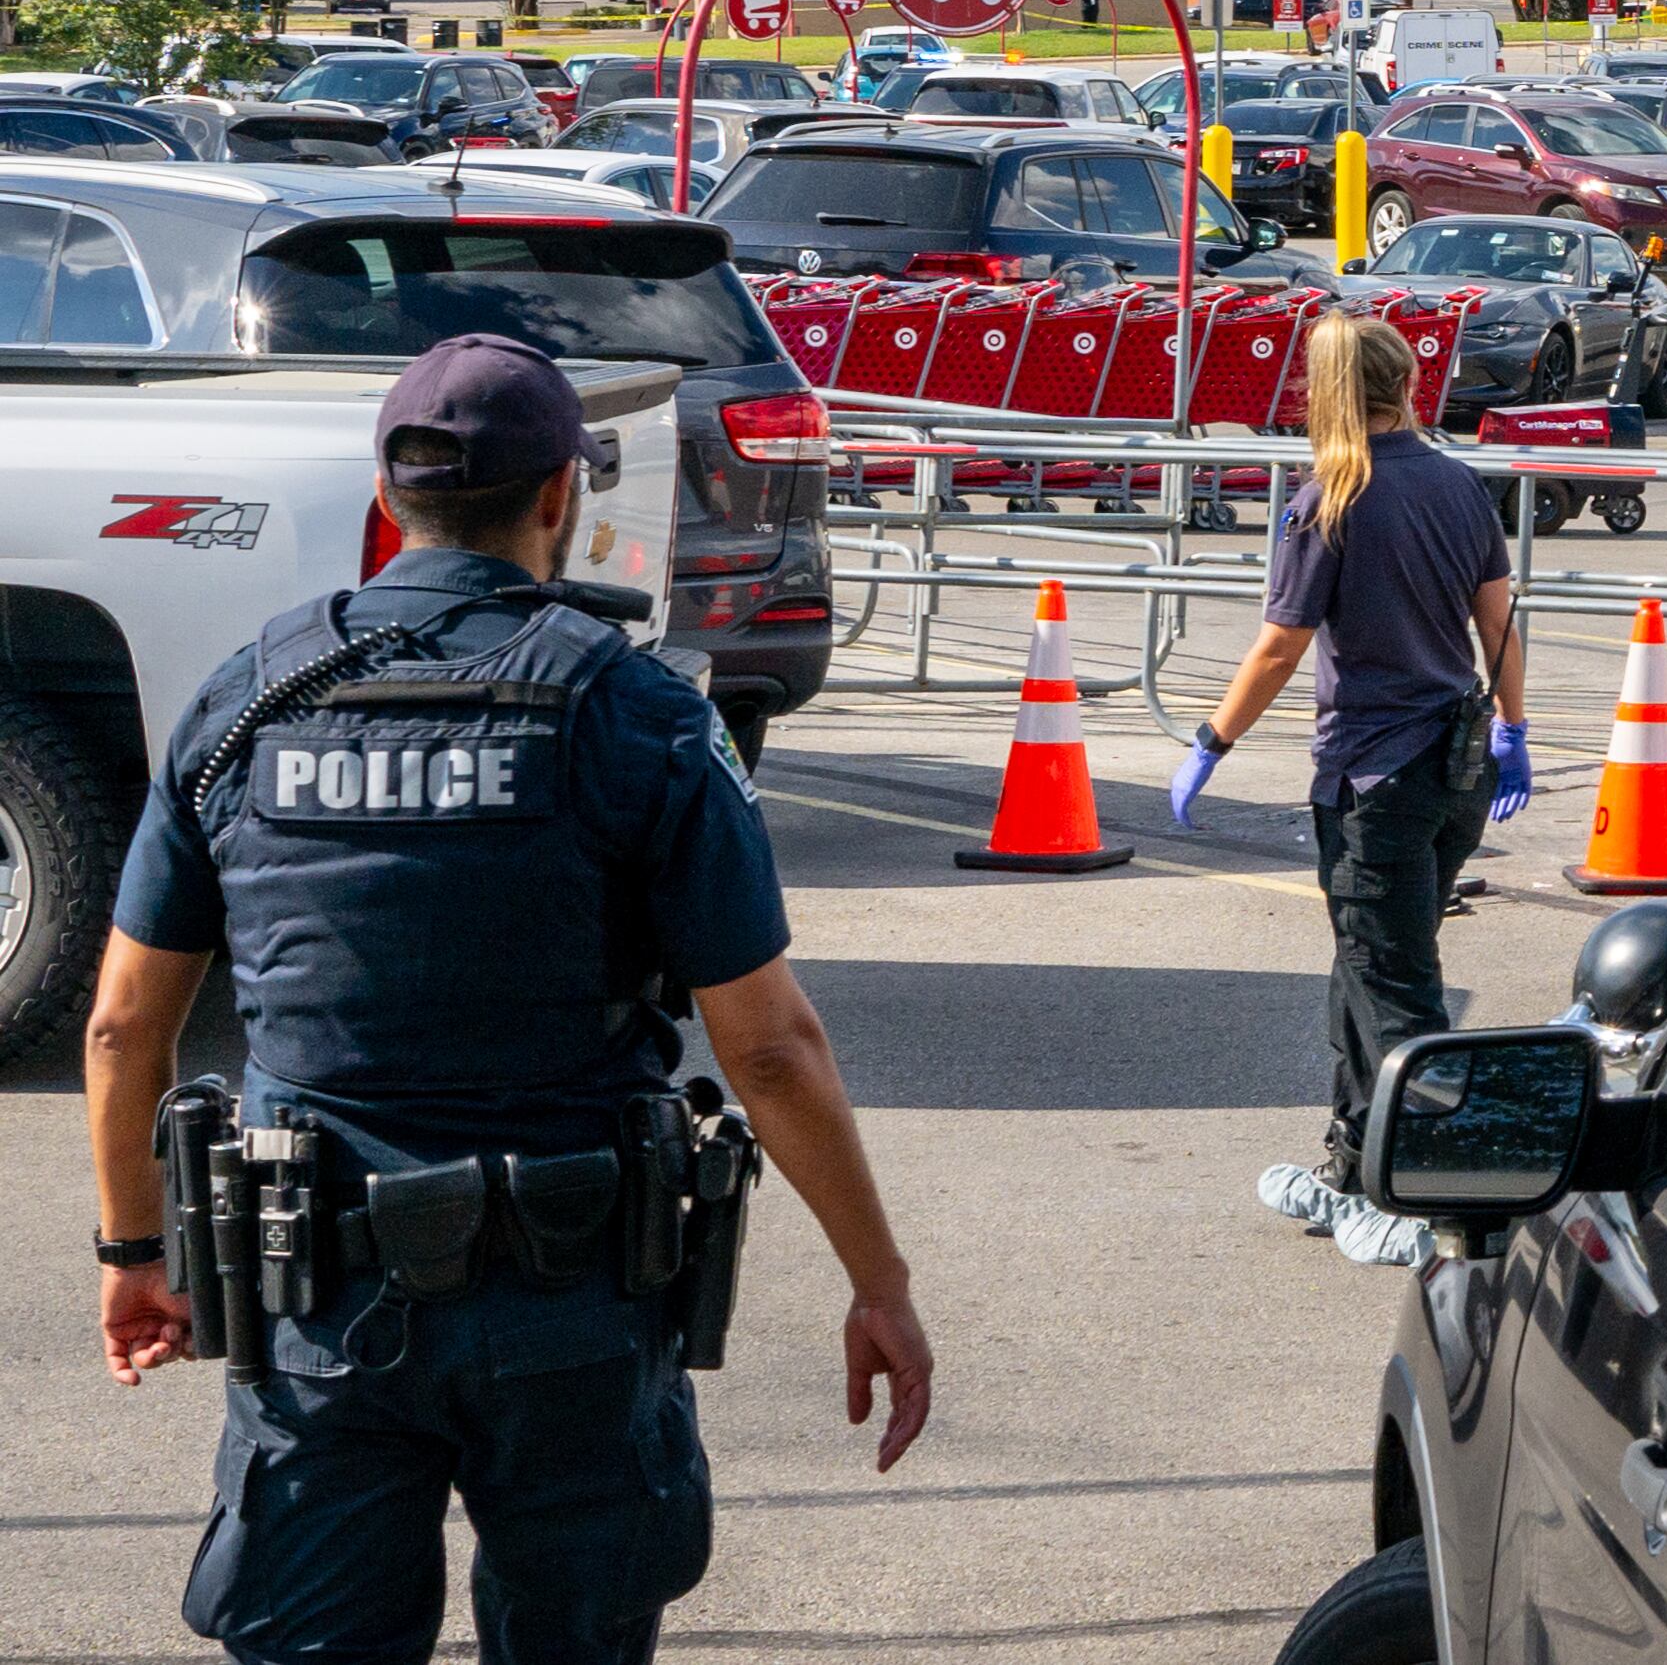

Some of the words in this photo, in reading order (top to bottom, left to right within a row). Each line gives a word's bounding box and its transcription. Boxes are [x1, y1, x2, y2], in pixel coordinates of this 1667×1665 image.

[1408, 41, 1443, 49] CRIME
[1448, 40, 1484, 48] SCENE
[99, 494, 269, 539] Z71
[173, 530, 258, 550] 4x4
[276, 748, 515, 809] POLICE
